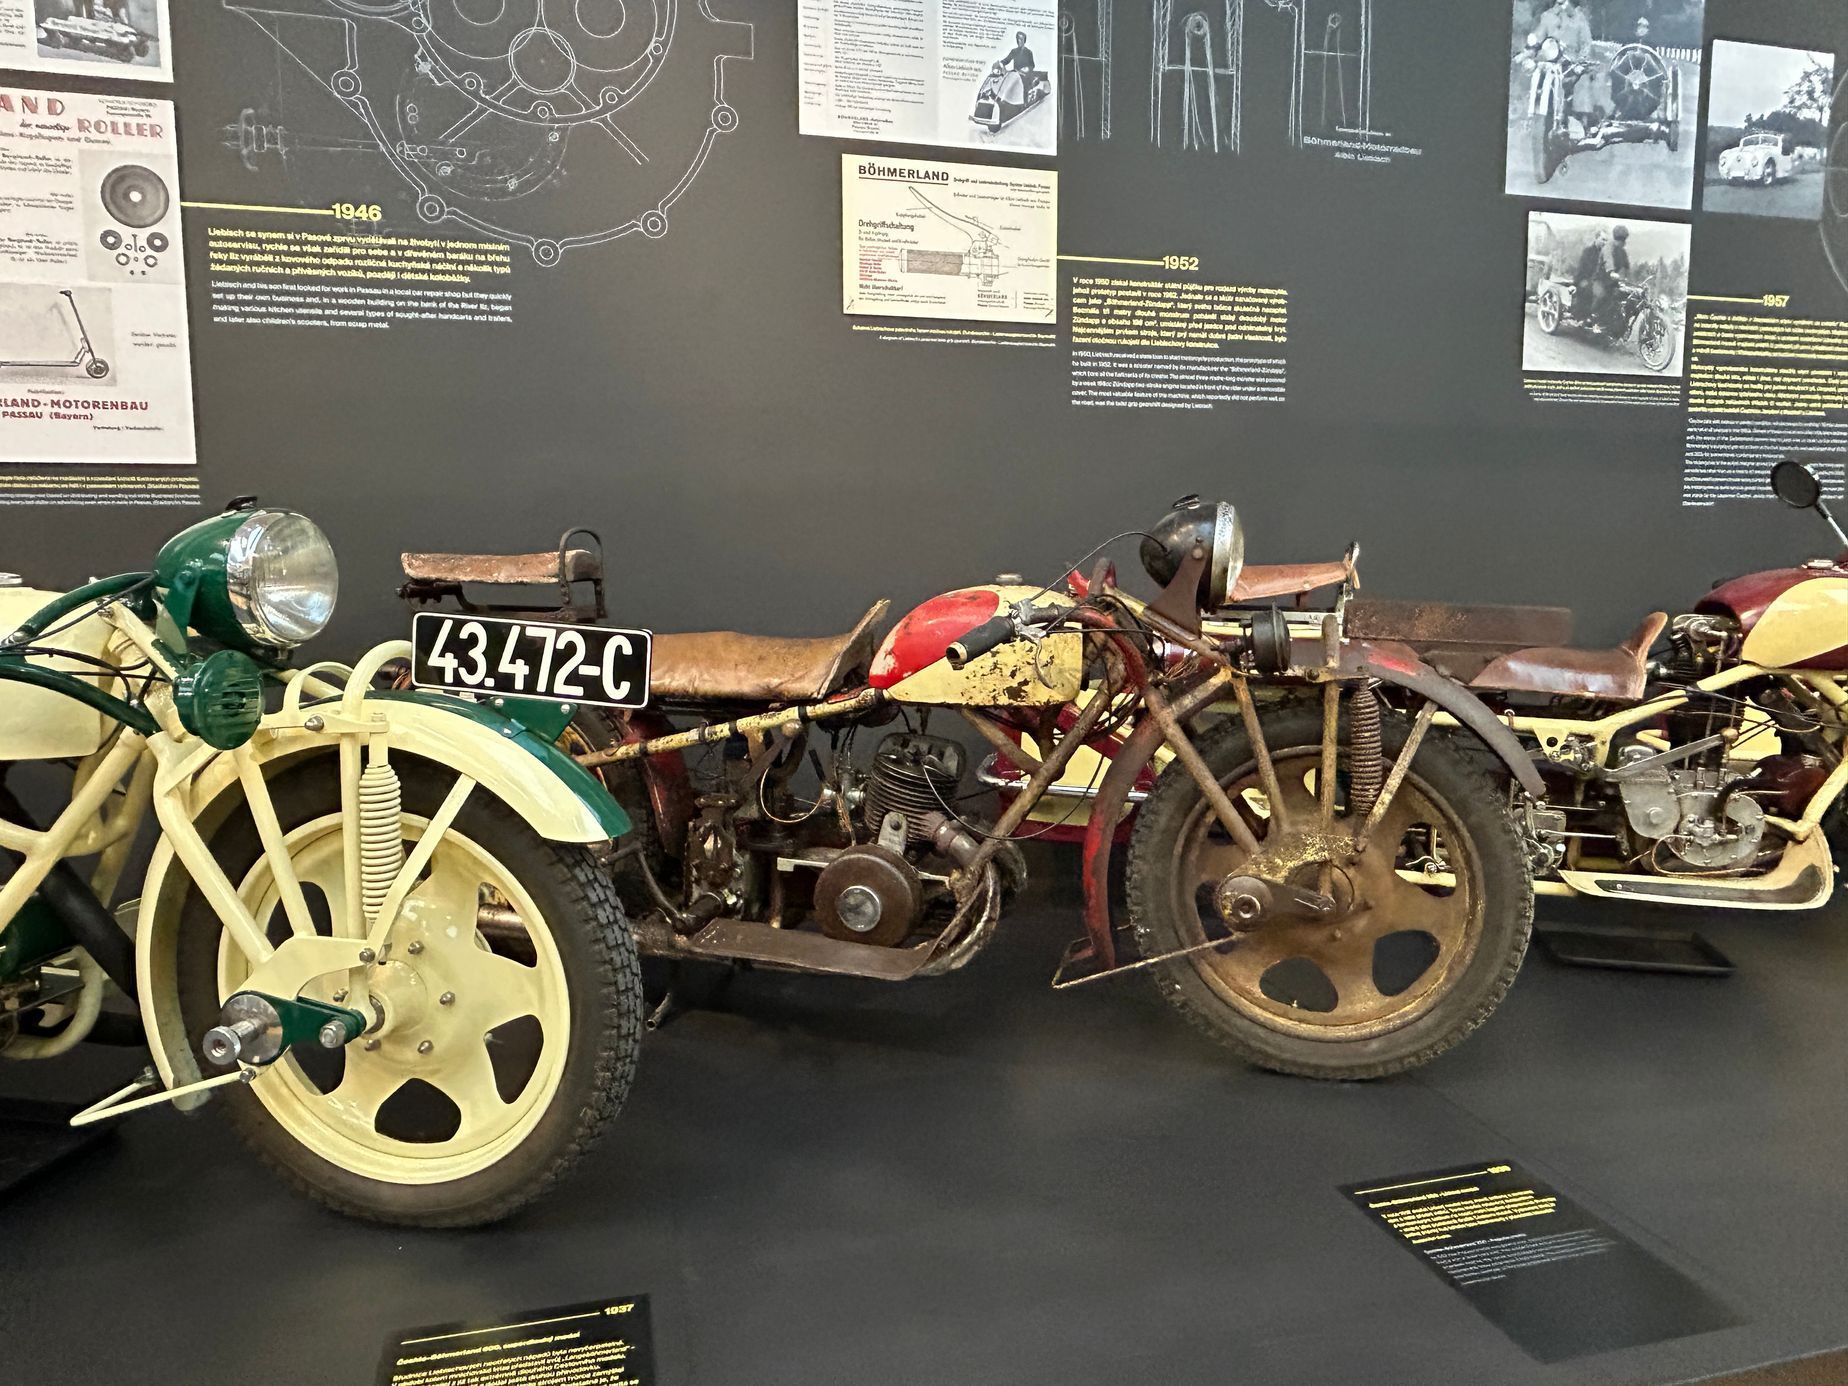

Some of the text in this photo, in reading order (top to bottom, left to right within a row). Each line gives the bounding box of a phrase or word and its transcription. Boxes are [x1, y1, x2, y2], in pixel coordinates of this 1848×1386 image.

[77, 118, 163, 139] ROLLER
[858, 162, 949, 181] BÖHMERLAND
[331, 202, 382, 221] 1946
[352, 248, 366, 256] pro
[1162, 255, 1199, 271] 1952
[1763, 294, 1790, 307] 1957
[0, 398, 149, 411] LAND-MOTORENBAU
[2, 411, 43, 419] PASSAU
[427, 618, 633, 700] 43.472-C
[604, 1303, 635, 1315] 1937
